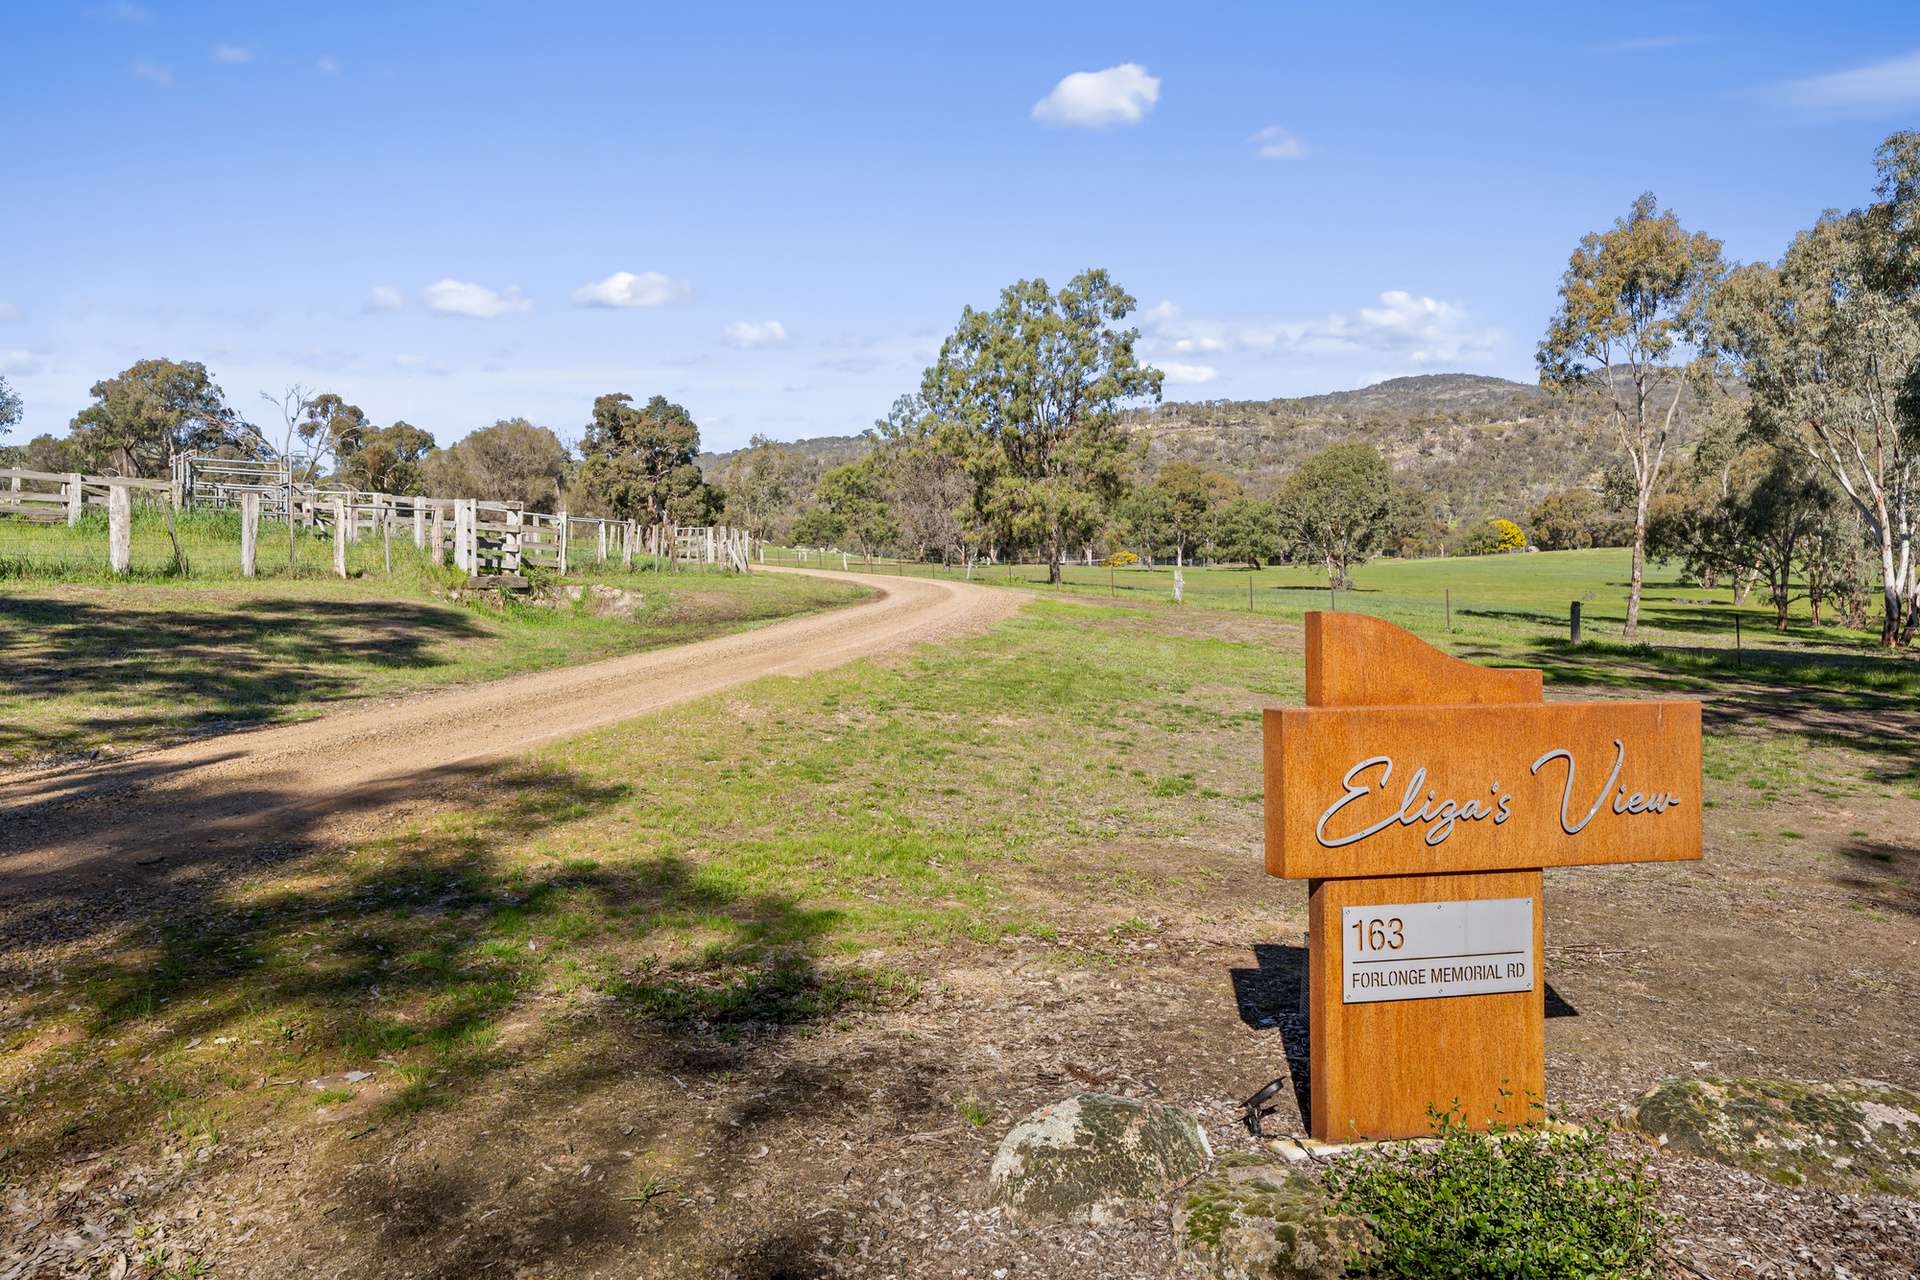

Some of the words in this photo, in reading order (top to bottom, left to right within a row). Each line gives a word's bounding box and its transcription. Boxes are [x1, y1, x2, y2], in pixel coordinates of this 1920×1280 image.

[1316, 756, 1512, 847] Eliza's
[1530, 739, 1681, 834] View
[1352, 918, 1405, 951] 163
[1352, 969, 1427, 989] FORLONGE
[1431, 965, 1503, 984] MEMORIAL
[1507, 963, 1525, 978] RD
